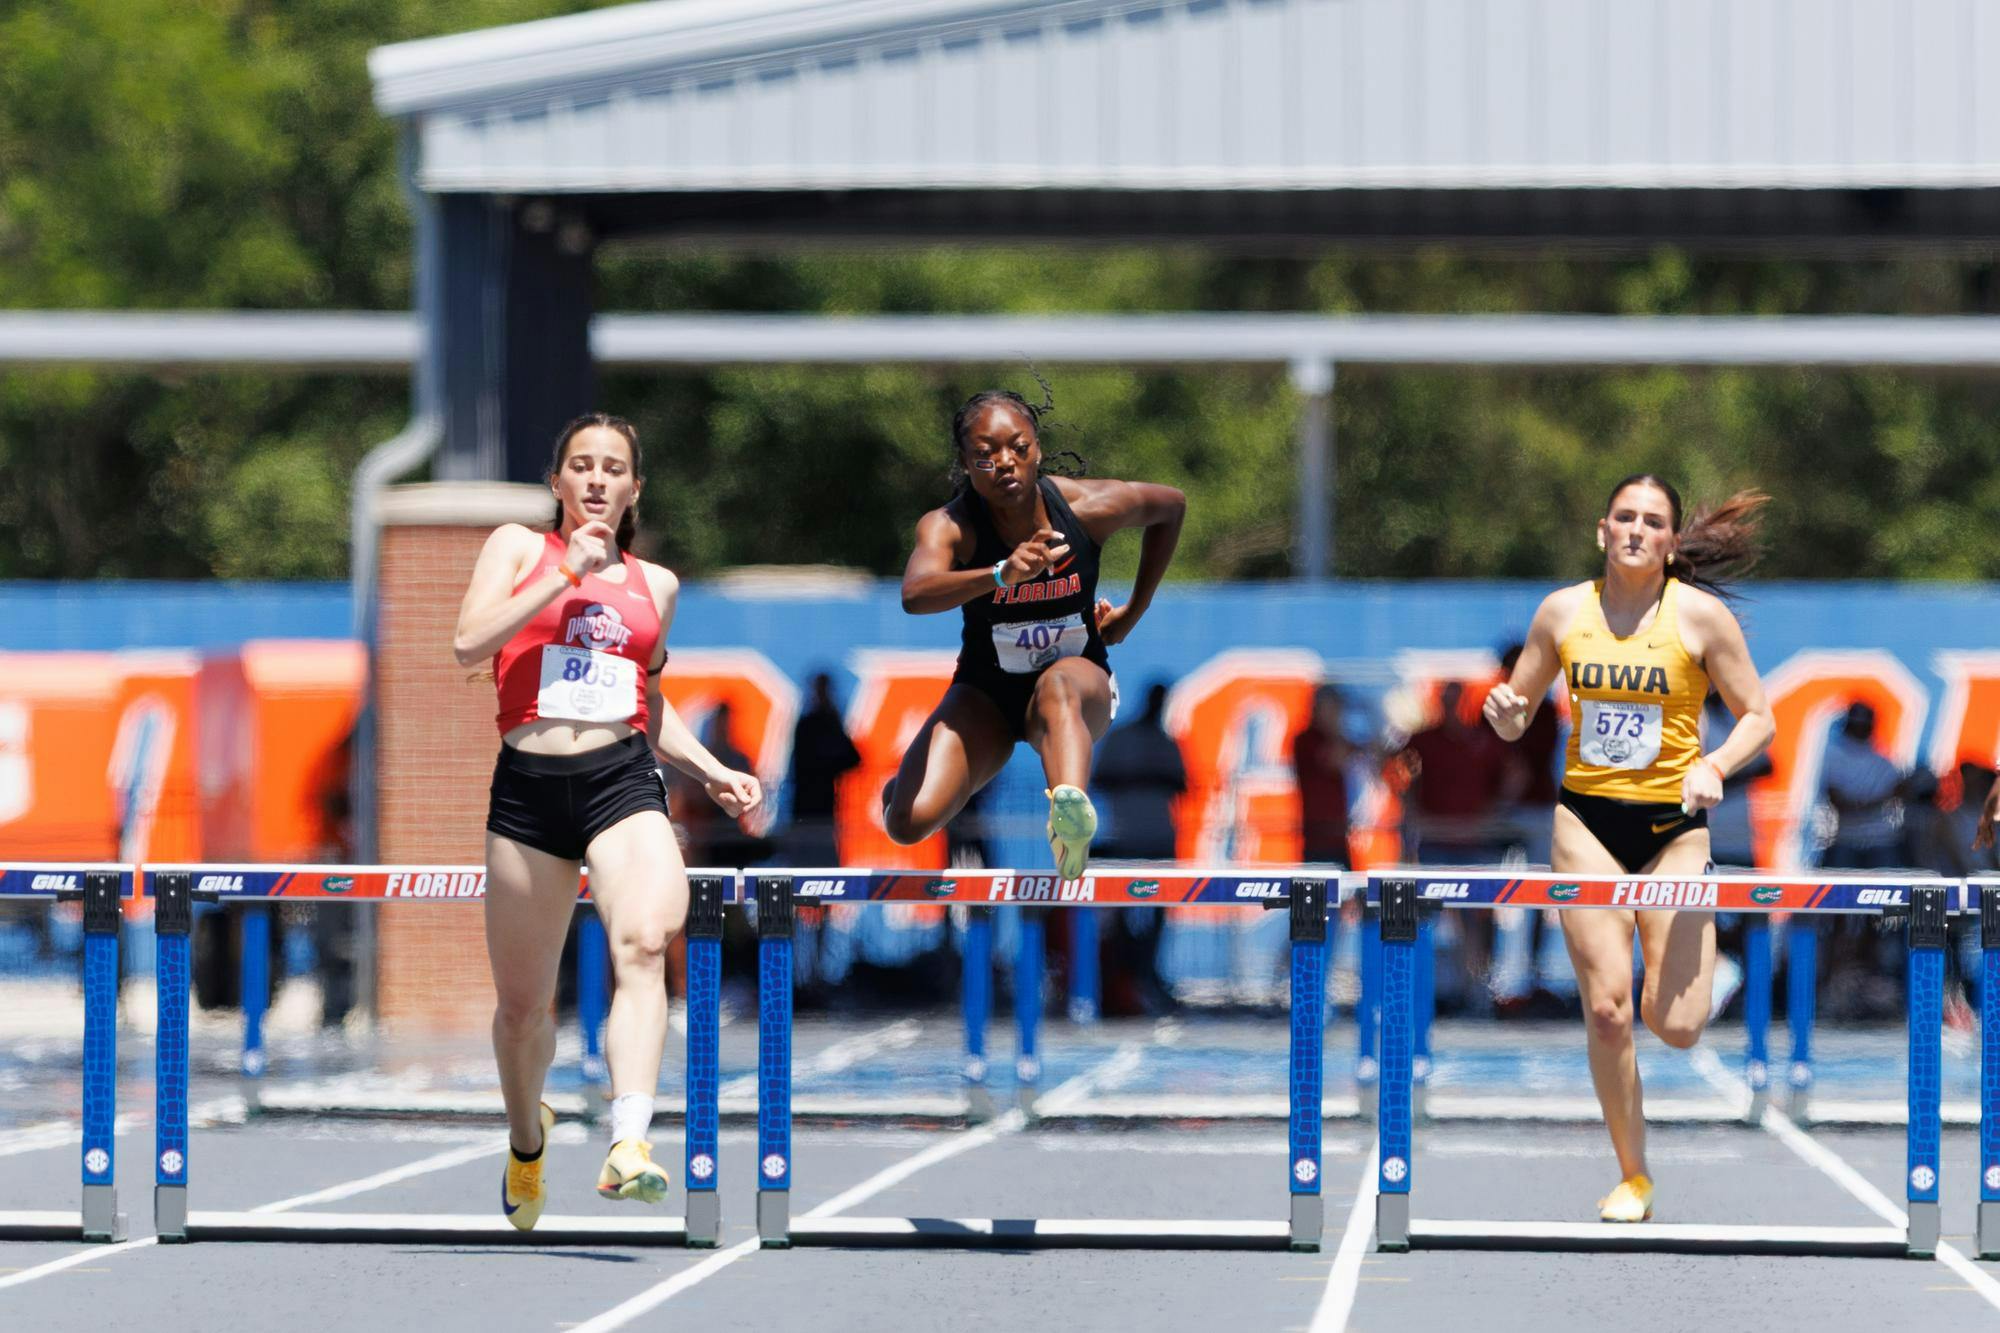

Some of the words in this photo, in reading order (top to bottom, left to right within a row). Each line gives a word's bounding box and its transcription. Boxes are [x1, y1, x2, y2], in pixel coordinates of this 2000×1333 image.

[992, 573, 1080, 604] FLORIDA
[1016, 625, 1065, 650] 407
[563, 657, 618, 688] 805
[1571, 662, 1670, 695] IOWA
[1596, 711, 1645, 737] 573
[31, 875, 77, 890] GILL
[198, 876, 243, 891] GILL
[800, 880, 846, 896] GILL
[988, 876, 1095, 901] FLORIDA
[1235, 882, 1281, 897] GILL
[1424, 883, 1470, 898] GILL
[1611, 882, 1718, 906] FLORIDA
[1856, 889, 1903, 904] GILL
